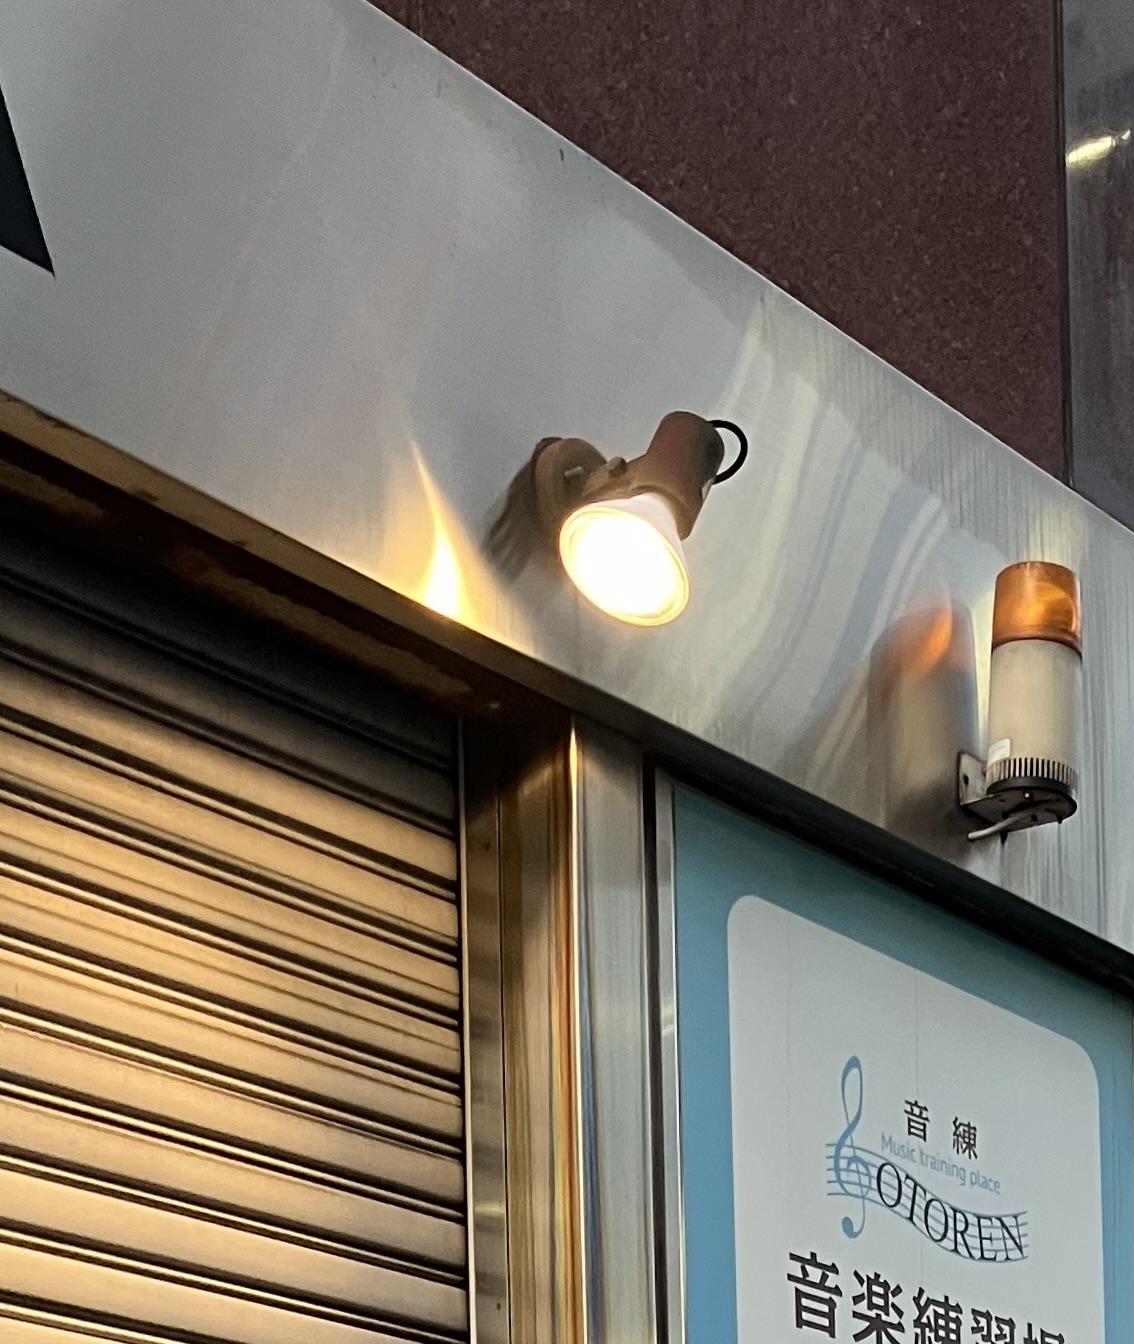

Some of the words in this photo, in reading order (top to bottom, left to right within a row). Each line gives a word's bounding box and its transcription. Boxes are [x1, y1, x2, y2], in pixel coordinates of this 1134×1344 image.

[881, 1132, 917, 1163] Music
[920, 1147, 966, 1186] training
[970, 1168, 1001, 1195] place
[876, 1162, 1025, 1262] OTOREN
